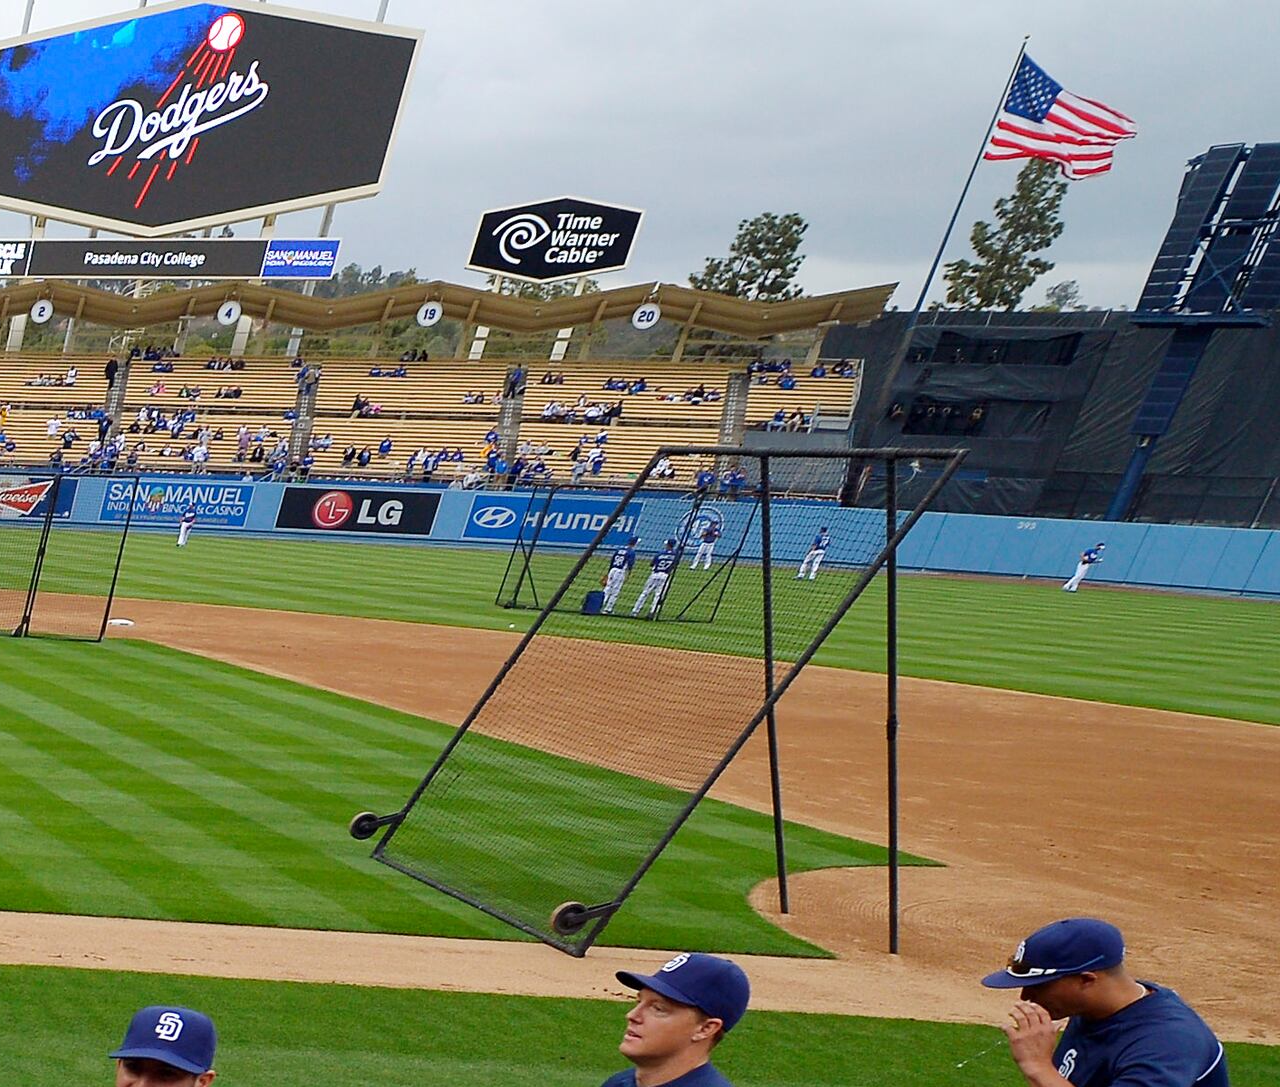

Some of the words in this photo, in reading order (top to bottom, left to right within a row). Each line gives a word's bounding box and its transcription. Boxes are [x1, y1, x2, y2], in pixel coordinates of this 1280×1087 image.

[88, 60, 269, 166] Dodgers
[556, 213, 603, 230] Time
[550, 230, 620, 247] Warner
[84, 251, 139, 265] Pasadena
[140, 252, 162, 267] City
[163, 252, 206, 268] College
[267, 250, 287, 260] SAN
[294, 250, 334, 260] MANUEL
[544, 247, 597, 263] Cable
[37, 306, 46, 317] 2
[224, 307, 233, 319] 4
[423, 308, 437, 320] 19
[637, 310, 655, 322] 20
[109, 483, 151, 502] SAN
[164, 485, 246, 505] MANUEL
[196, 506, 205, 514] &
[205, 506, 245, 516] CASINO
[356, 499, 404, 526] LG
[523, 511, 634, 533] HYUNDAI
[155, 1012, 183, 1041] SD
